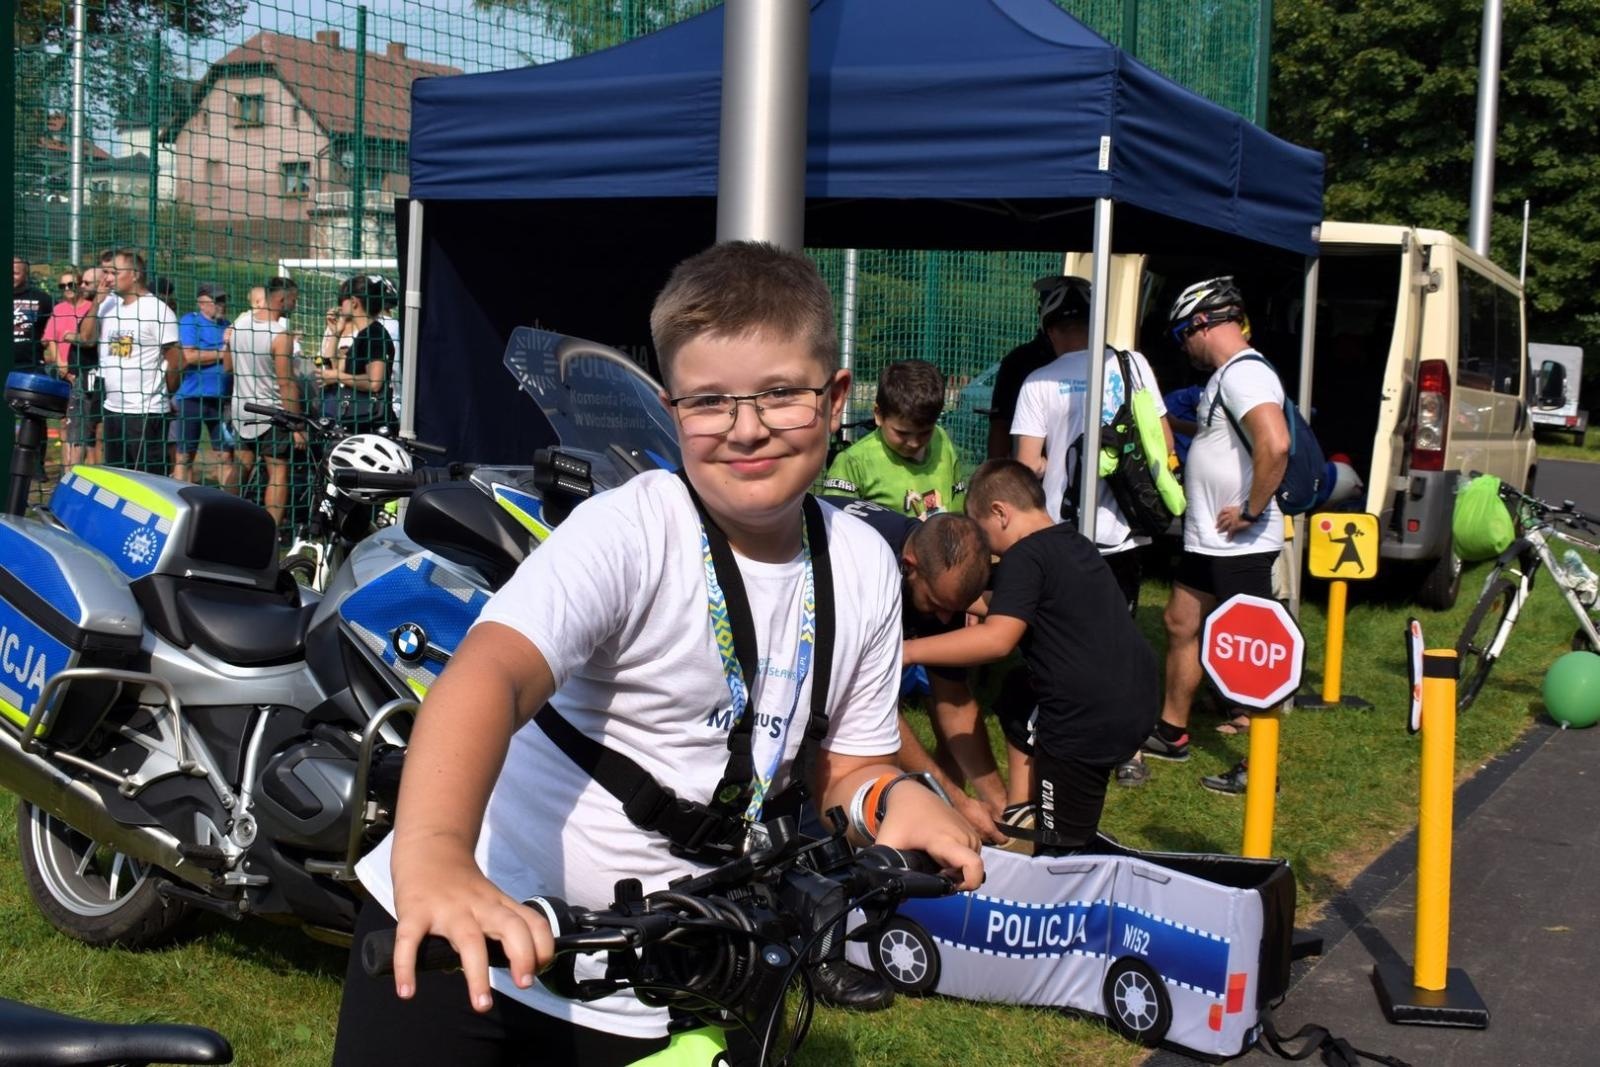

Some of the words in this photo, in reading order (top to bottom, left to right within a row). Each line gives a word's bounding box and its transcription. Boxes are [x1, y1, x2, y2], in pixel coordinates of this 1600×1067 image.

[1215, 632, 1287, 670] STOP
[1041, 779, 1054, 810] WILD
[1042, 811, 1054, 830] GO
[986, 910, 1087, 948] POLICJA
